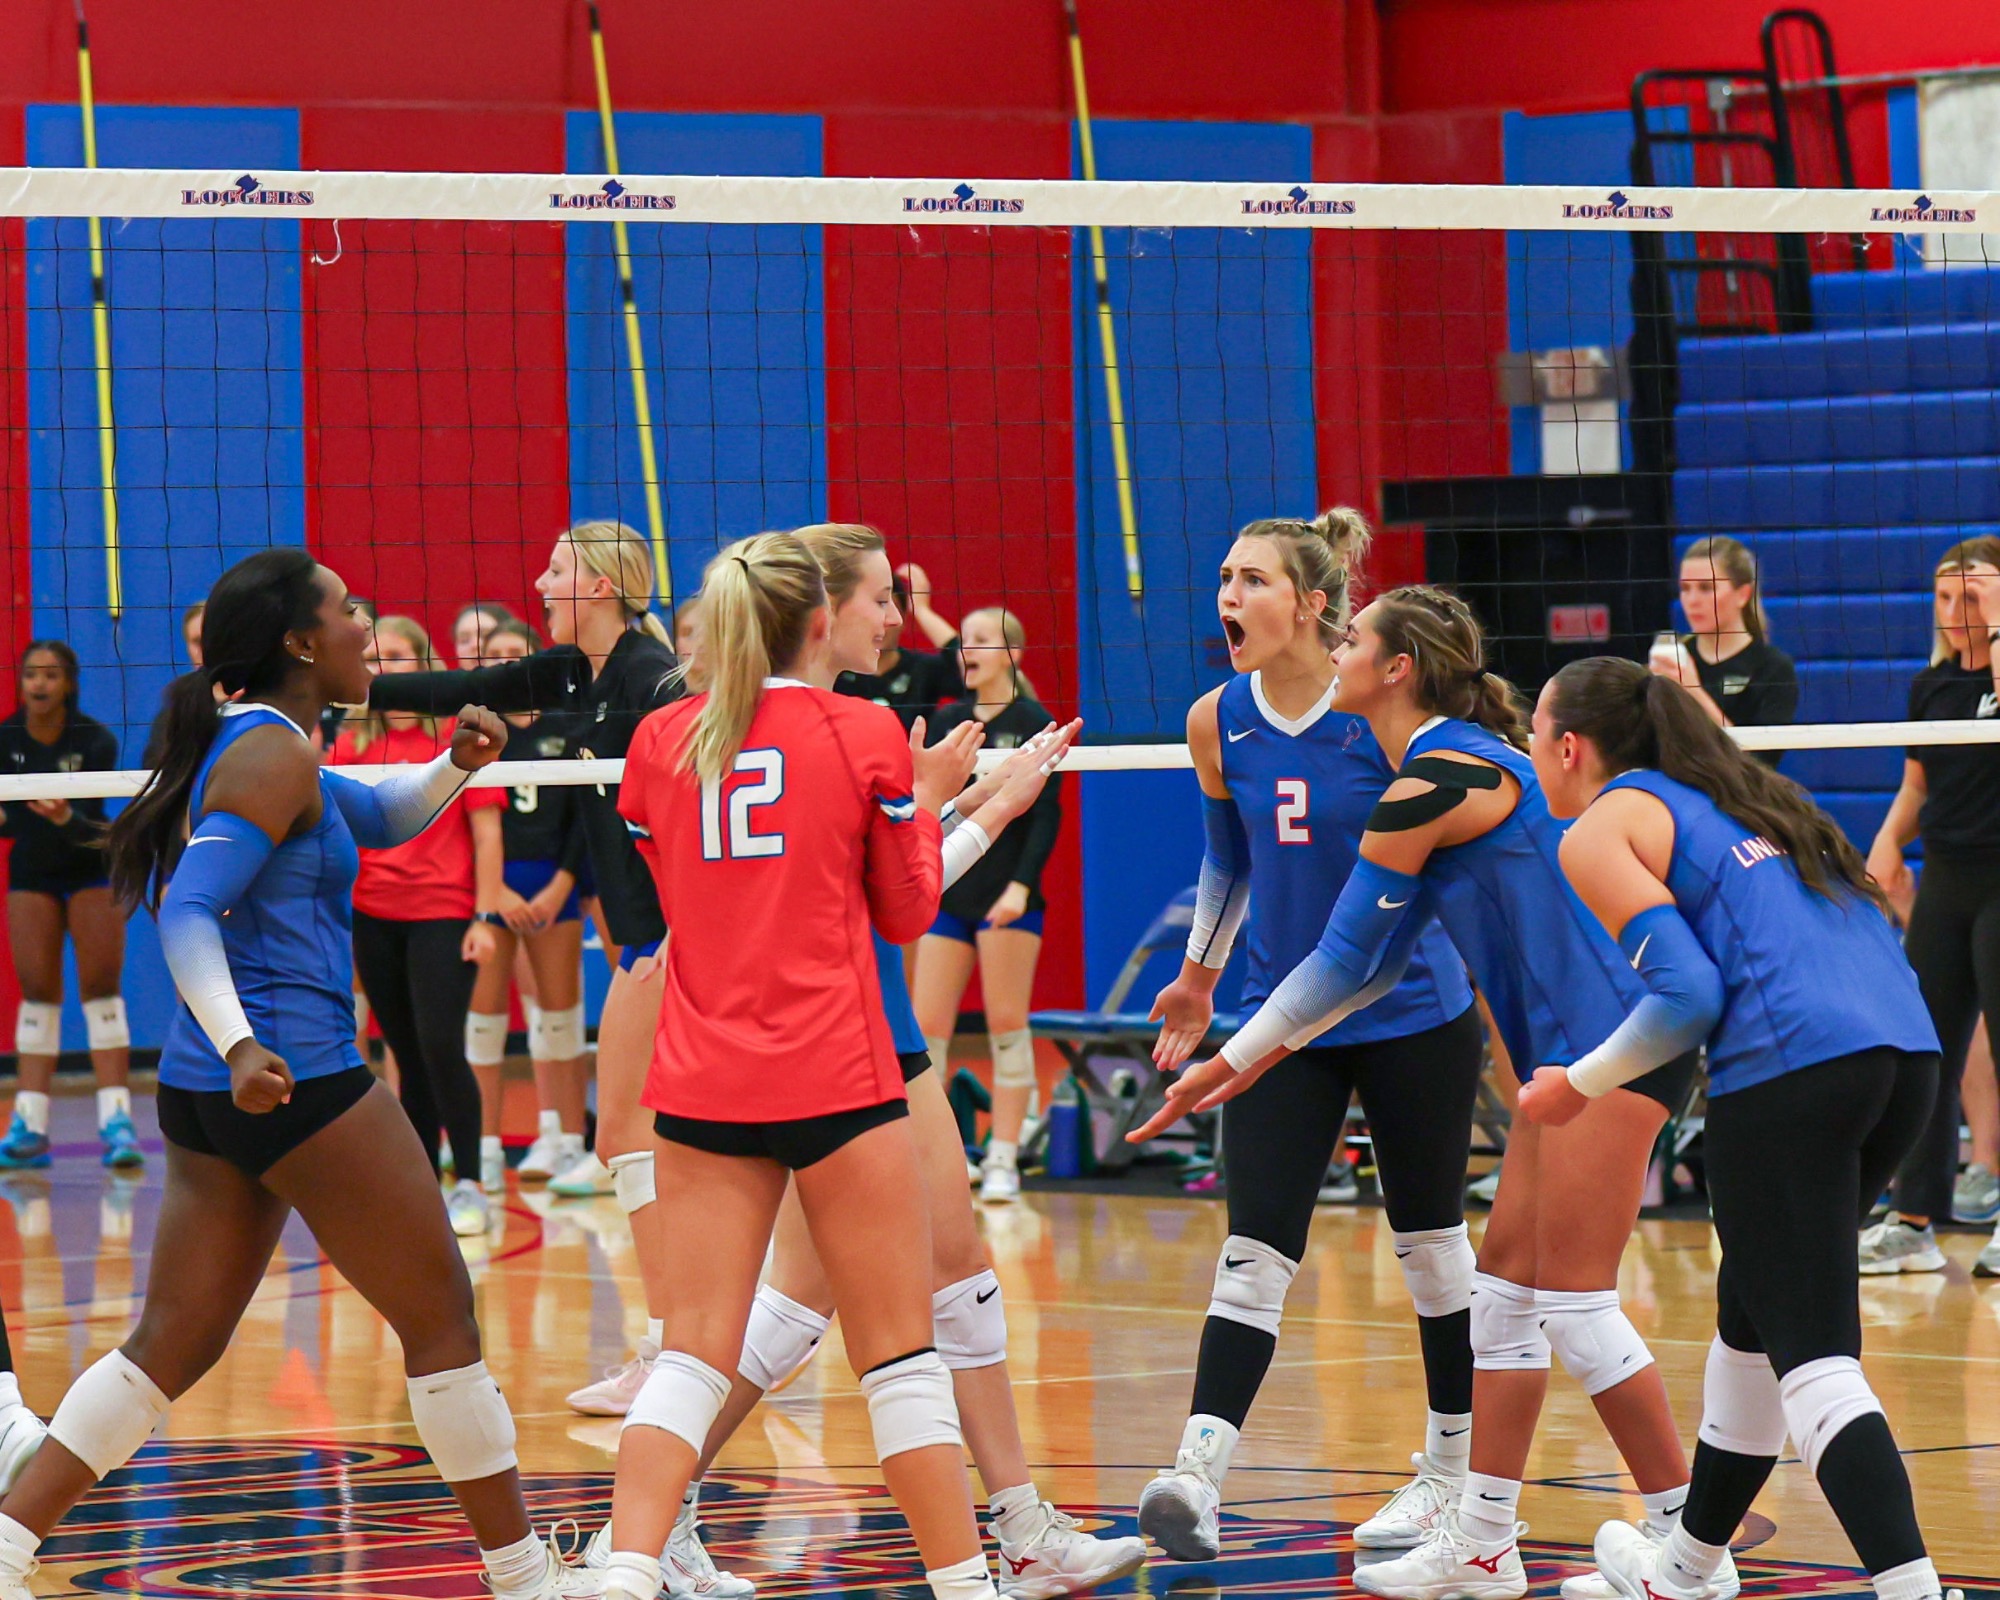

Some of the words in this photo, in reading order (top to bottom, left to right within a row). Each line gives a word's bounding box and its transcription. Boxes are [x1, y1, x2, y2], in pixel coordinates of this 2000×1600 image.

[181, 189, 315, 206] LOGGERS
[549, 193, 677, 210] LOGGERS
[902, 197, 1025, 213] LOGGERS
[1241, 199, 1356, 215] LOGGERS
[1562, 204, 1674, 219] LOGGERS
[1869, 207, 1976, 222] LOGGERS
[694, 746, 785, 861] 12
[1274, 777, 1313, 845] 2
